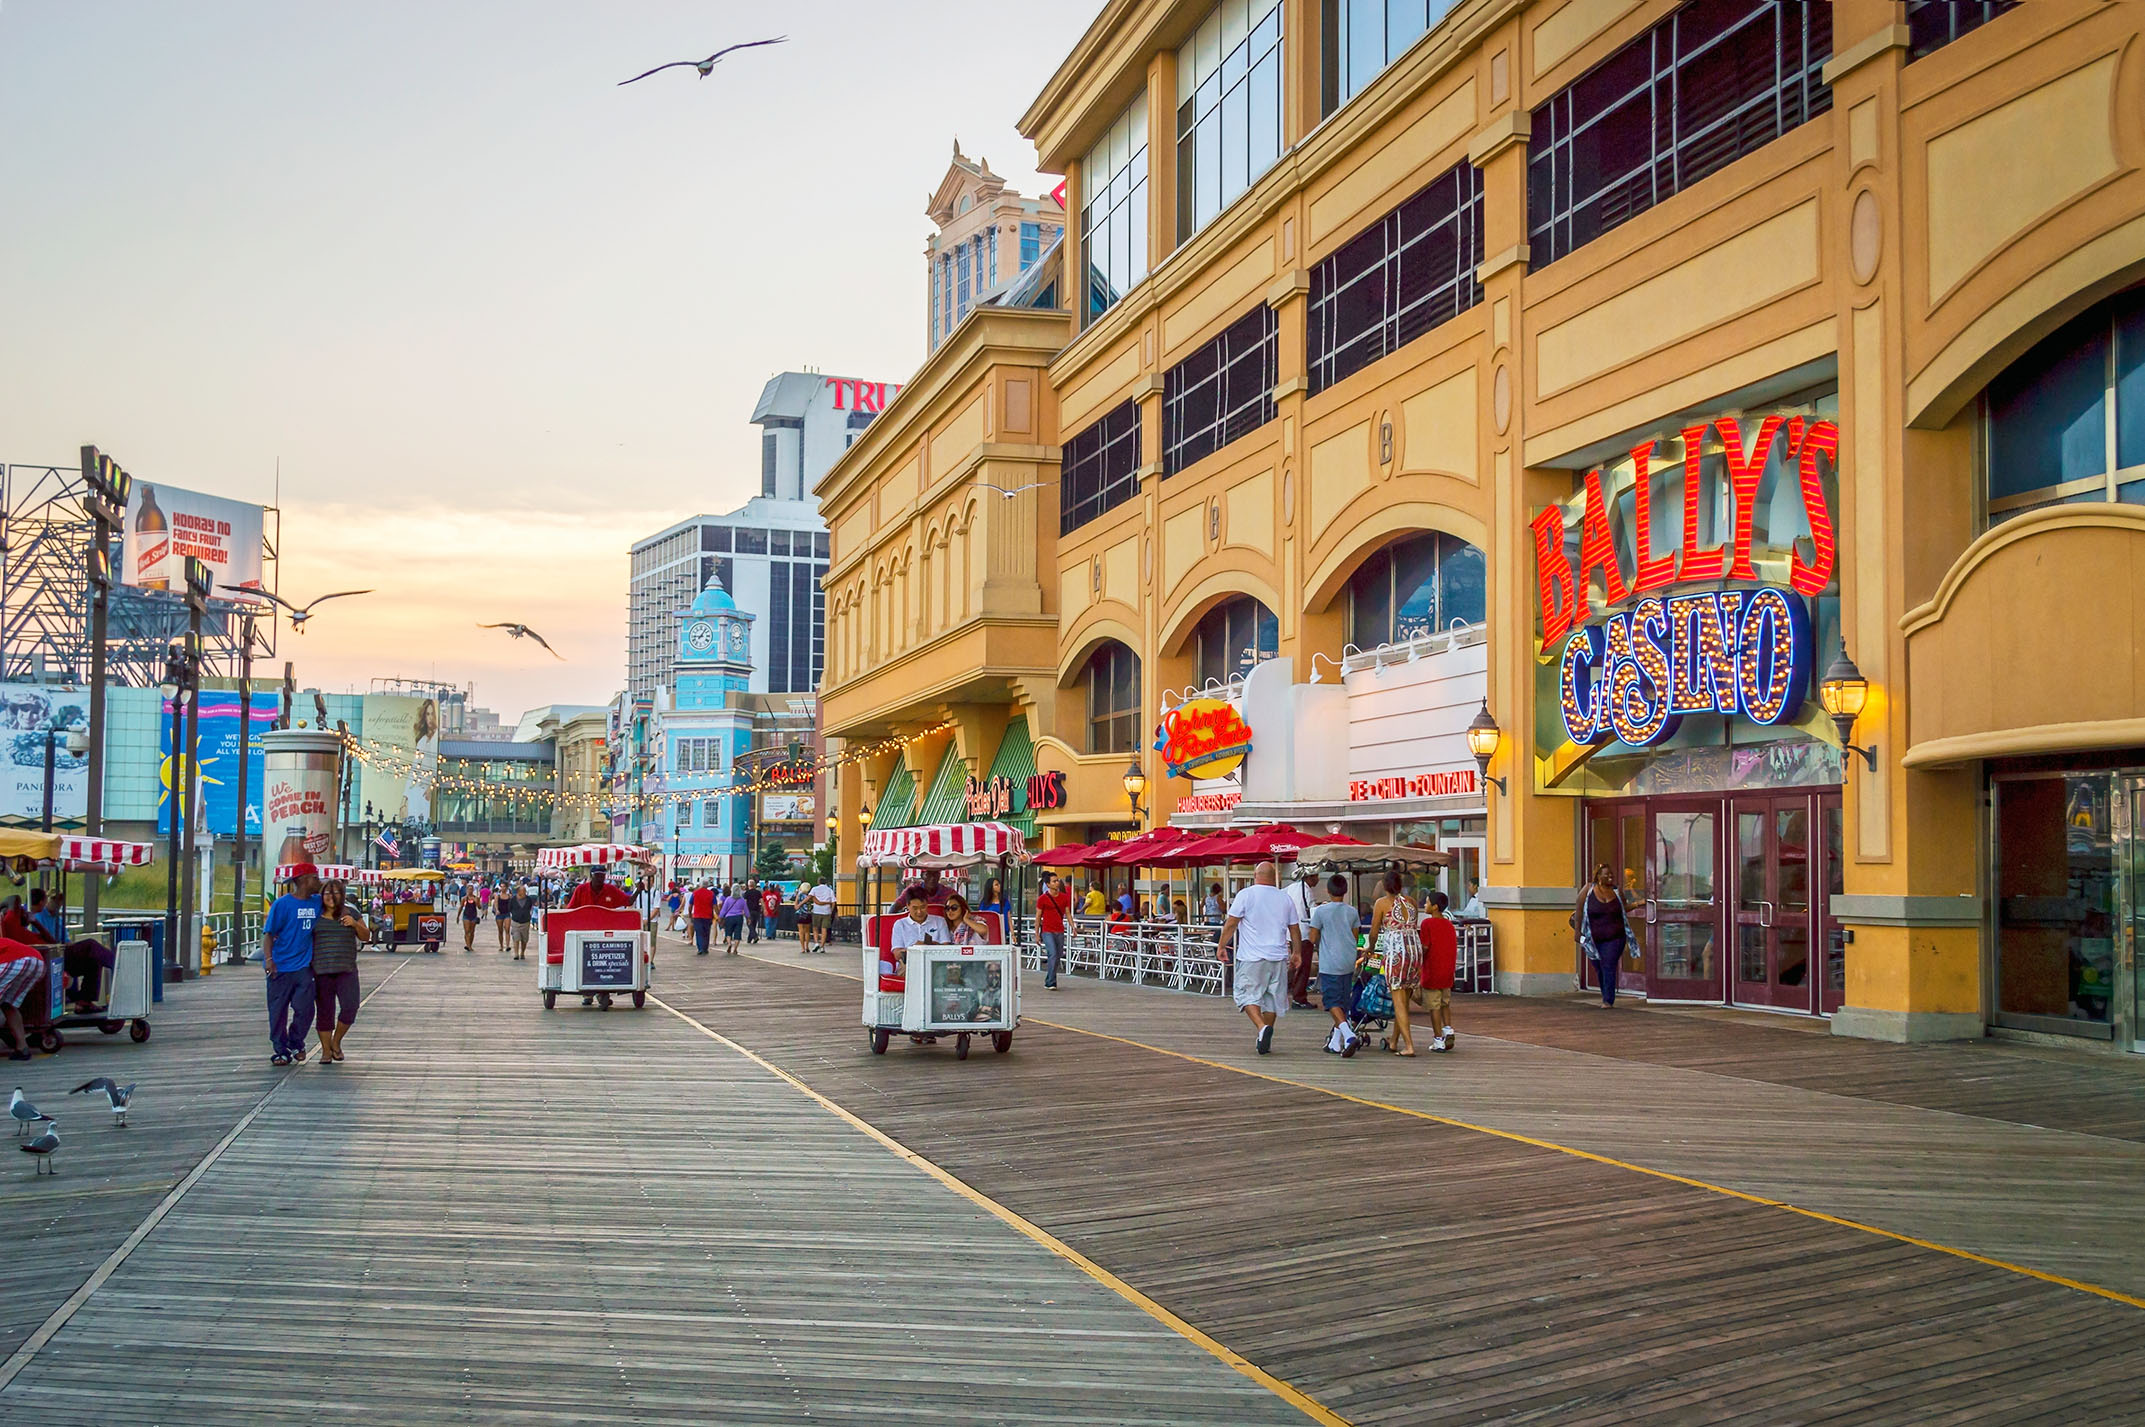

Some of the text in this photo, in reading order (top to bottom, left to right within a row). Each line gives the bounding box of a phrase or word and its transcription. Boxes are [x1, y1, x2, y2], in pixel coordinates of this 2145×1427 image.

[1380, 423, 1392, 465] B
[172, 512, 231, 536] HOORAY NO
[173, 528, 222, 547] FANCY FRUIT
[1210, 506, 1219, 541] B
[1529, 415, 1839, 653] BALLY'S
[1560, 588, 1794, 746] CASINO
[1162, 704, 1240, 763] Johnny
[1173, 721, 1253, 764] Rockets
[268, 791, 321, 811] COME IN
[271, 781, 294, 798] We
[965, 775, 1010, 820] Pickles Deli
[1027, 770, 1059, 810] LLY'S
[1349, 770, 1475, 801] PIE CHILI FOUNTAIN
[270, 801, 328, 824] PEACH.
[1177, 794, 1224, 814] HAMBURGERS
